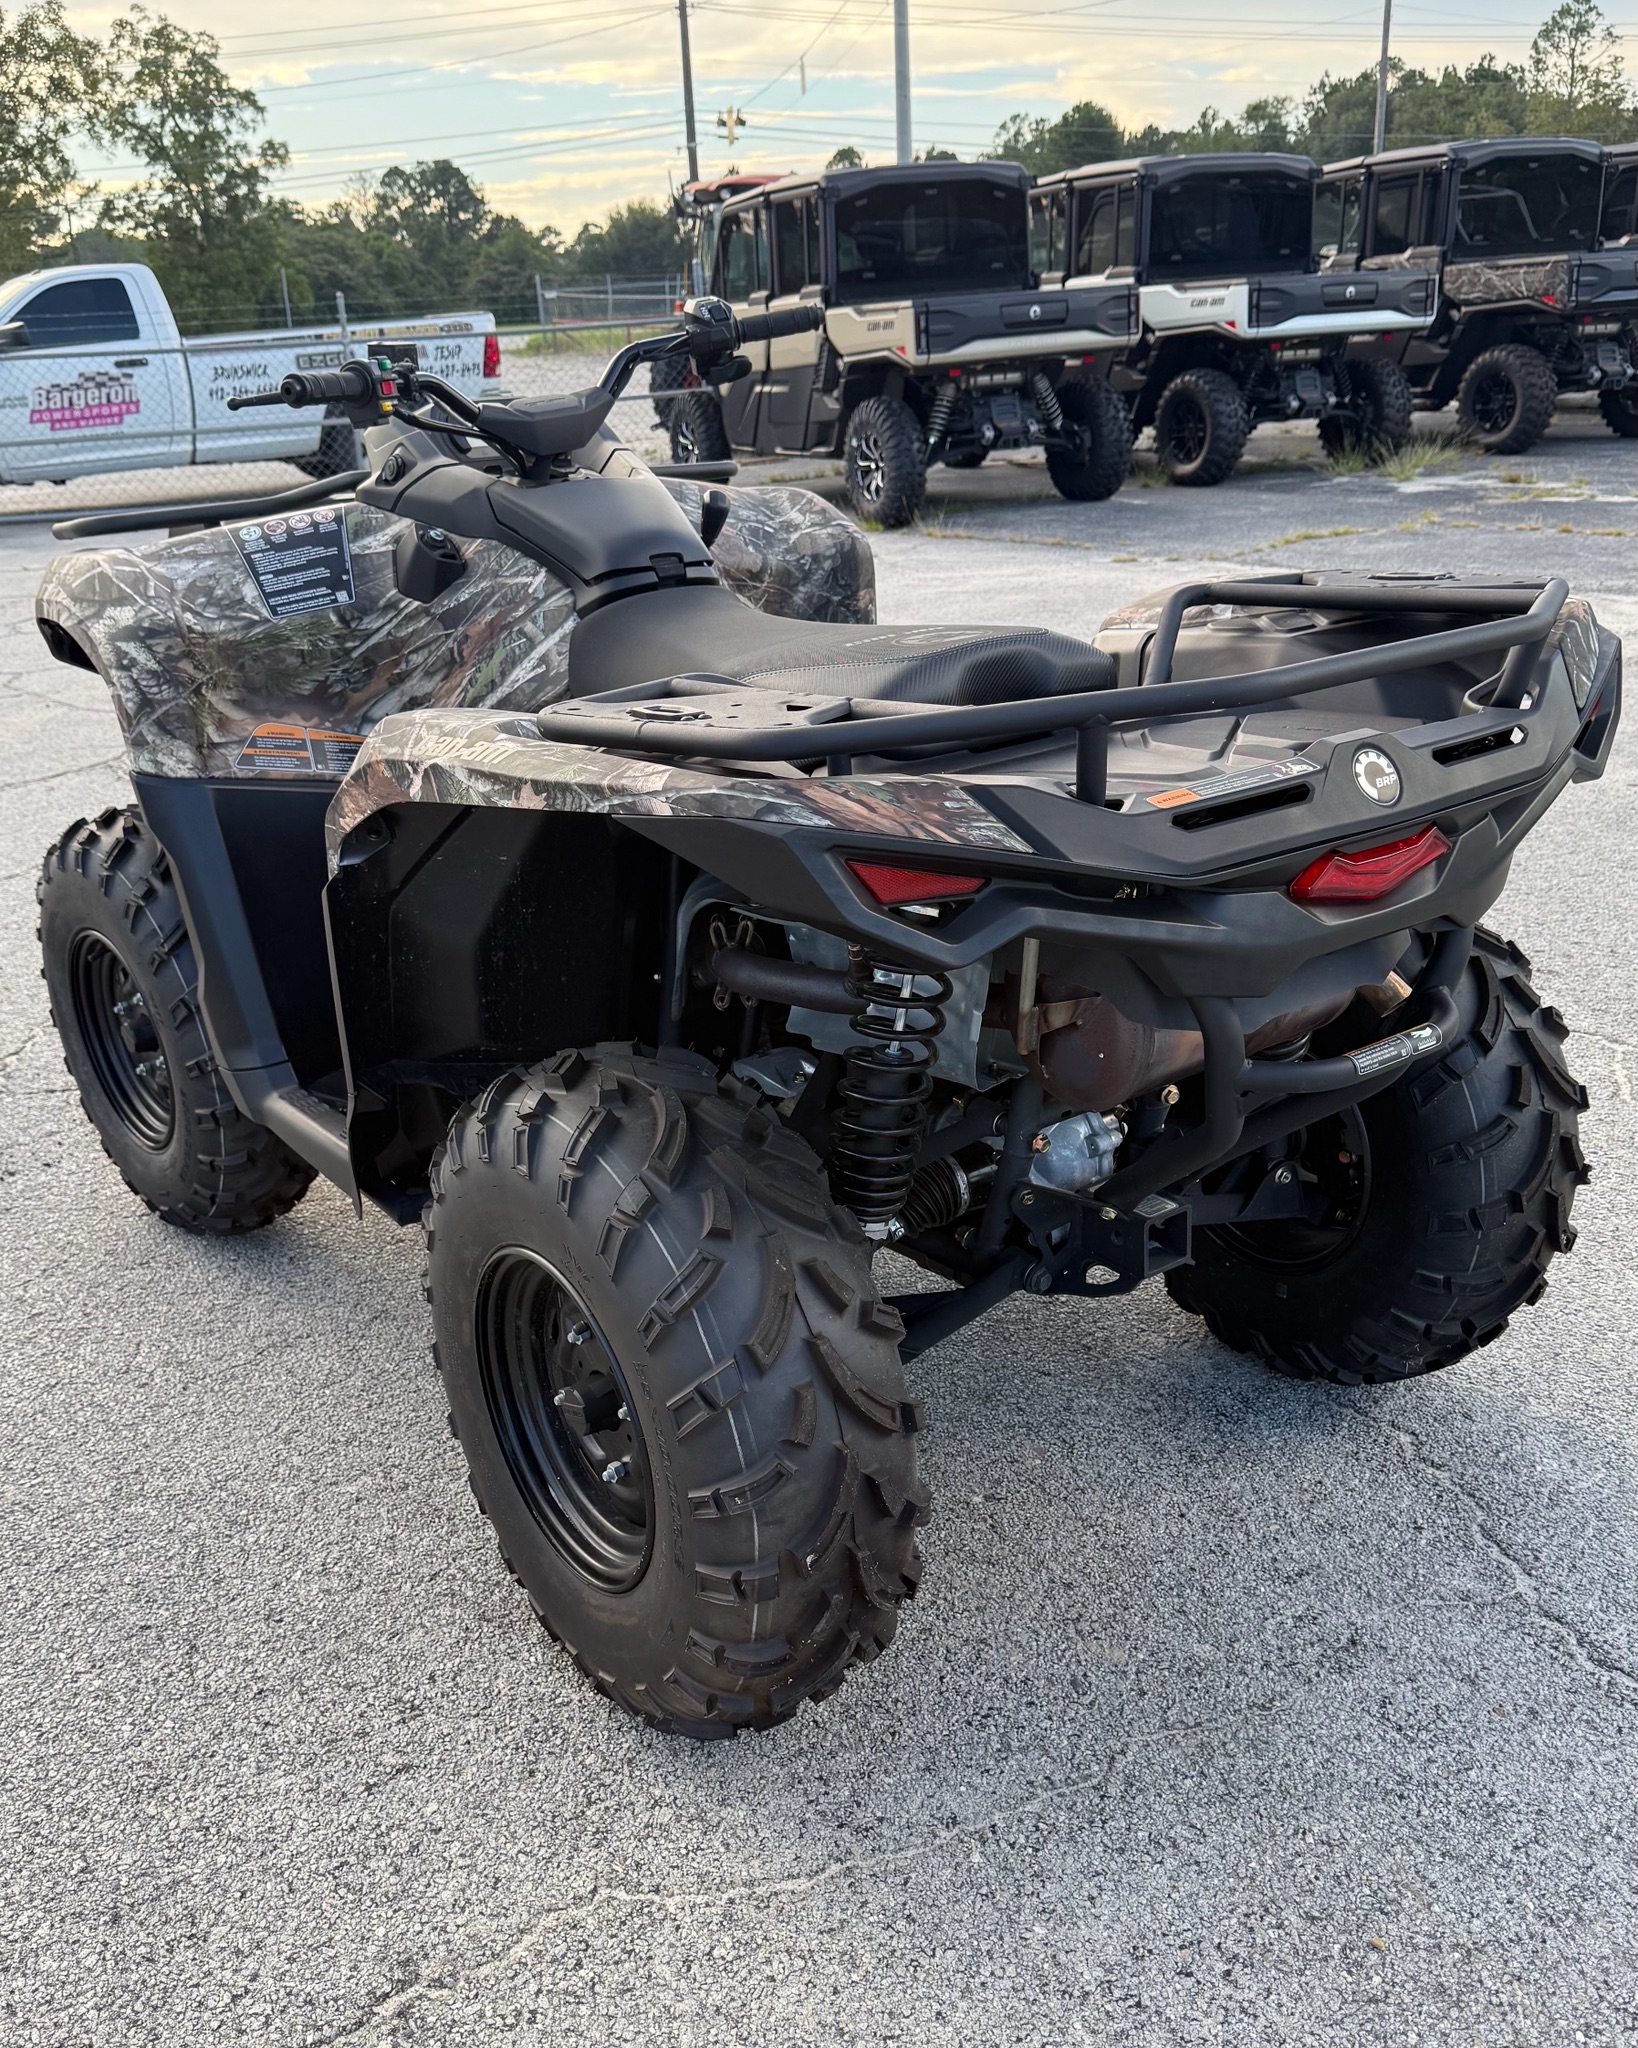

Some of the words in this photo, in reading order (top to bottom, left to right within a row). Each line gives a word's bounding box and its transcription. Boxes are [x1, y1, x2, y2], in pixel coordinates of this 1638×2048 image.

[33, 384, 138, 411] Bargeron
[31, 404, 138, 422] POWERSPORTS
[412, 734, 517, 764] can-am
[1375, 773, 1397, 788] BRP
